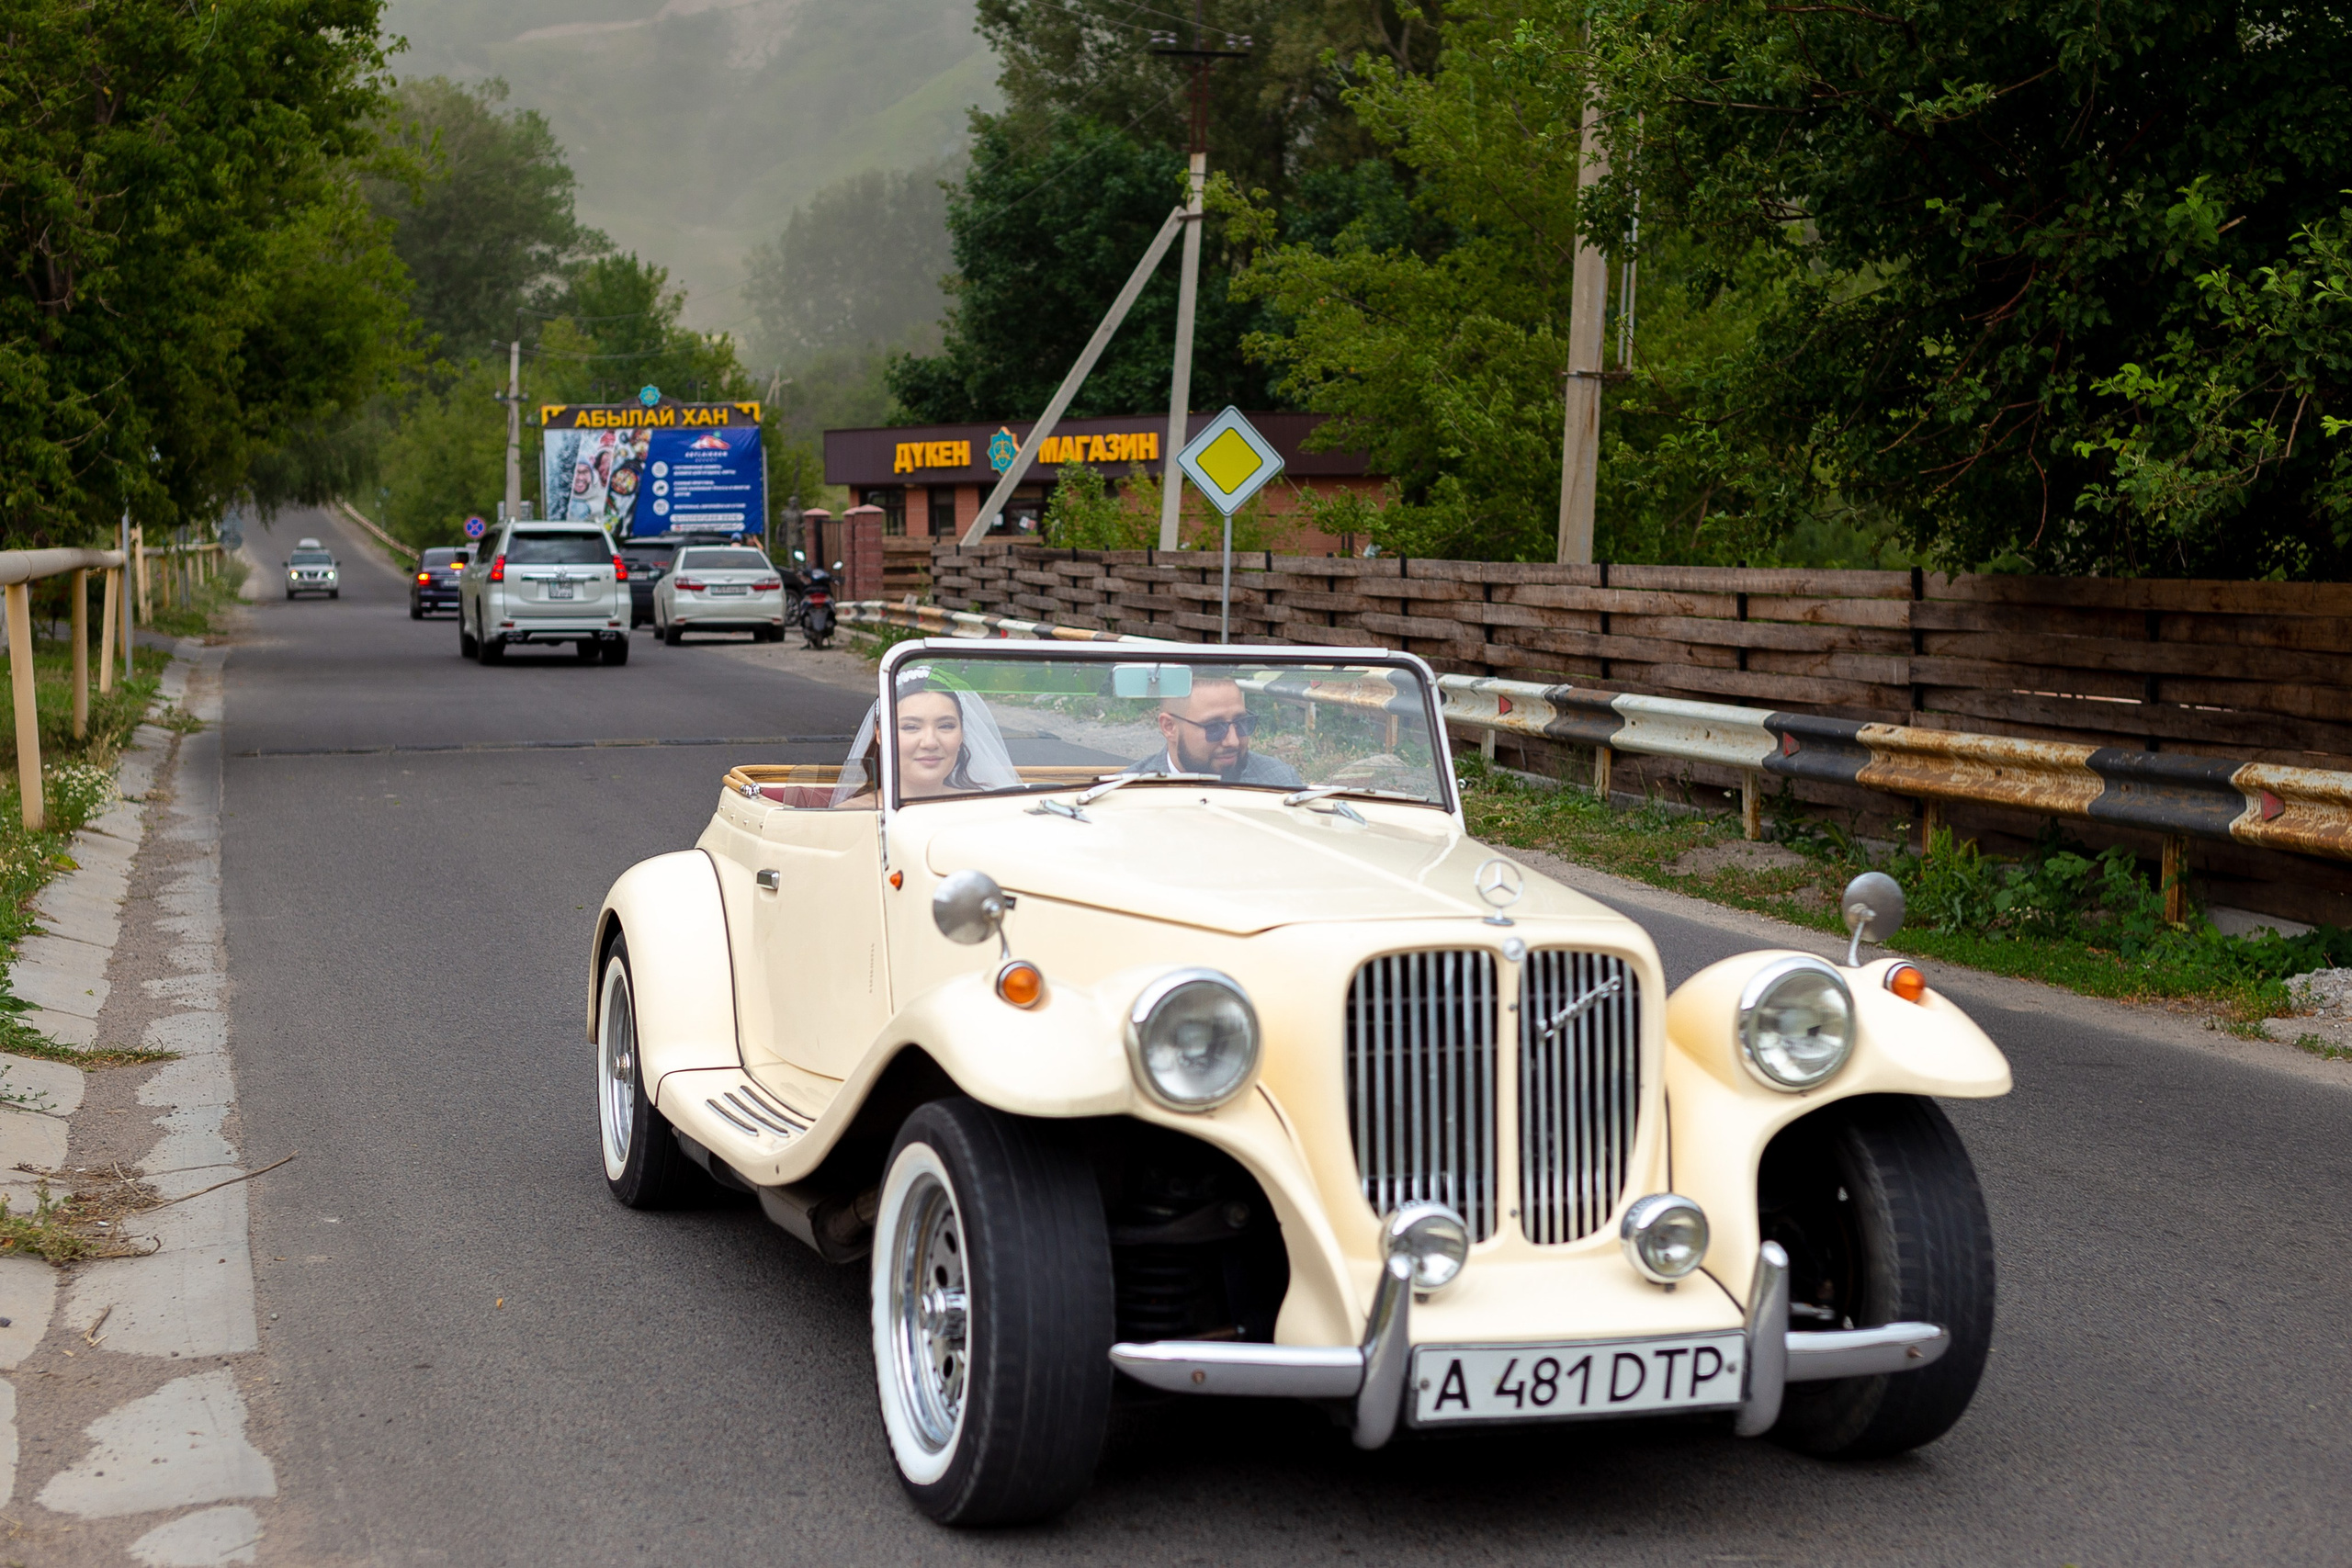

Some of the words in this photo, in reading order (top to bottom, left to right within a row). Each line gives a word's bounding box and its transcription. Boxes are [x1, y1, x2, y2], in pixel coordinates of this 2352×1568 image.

[575, 406, 675, 427] АБЫЛАЙ
[682, 408, 729, 425] ХАН
[894, 440, 971, 473] ДҮКЕН
[1039, 433, 1159, 463] МАГАЗИН
[1434, 1359, 1470, 1410] A
[1494, 1353, 1593, 1409] 481
[1609, 1346, 1723, 1403] DTP
